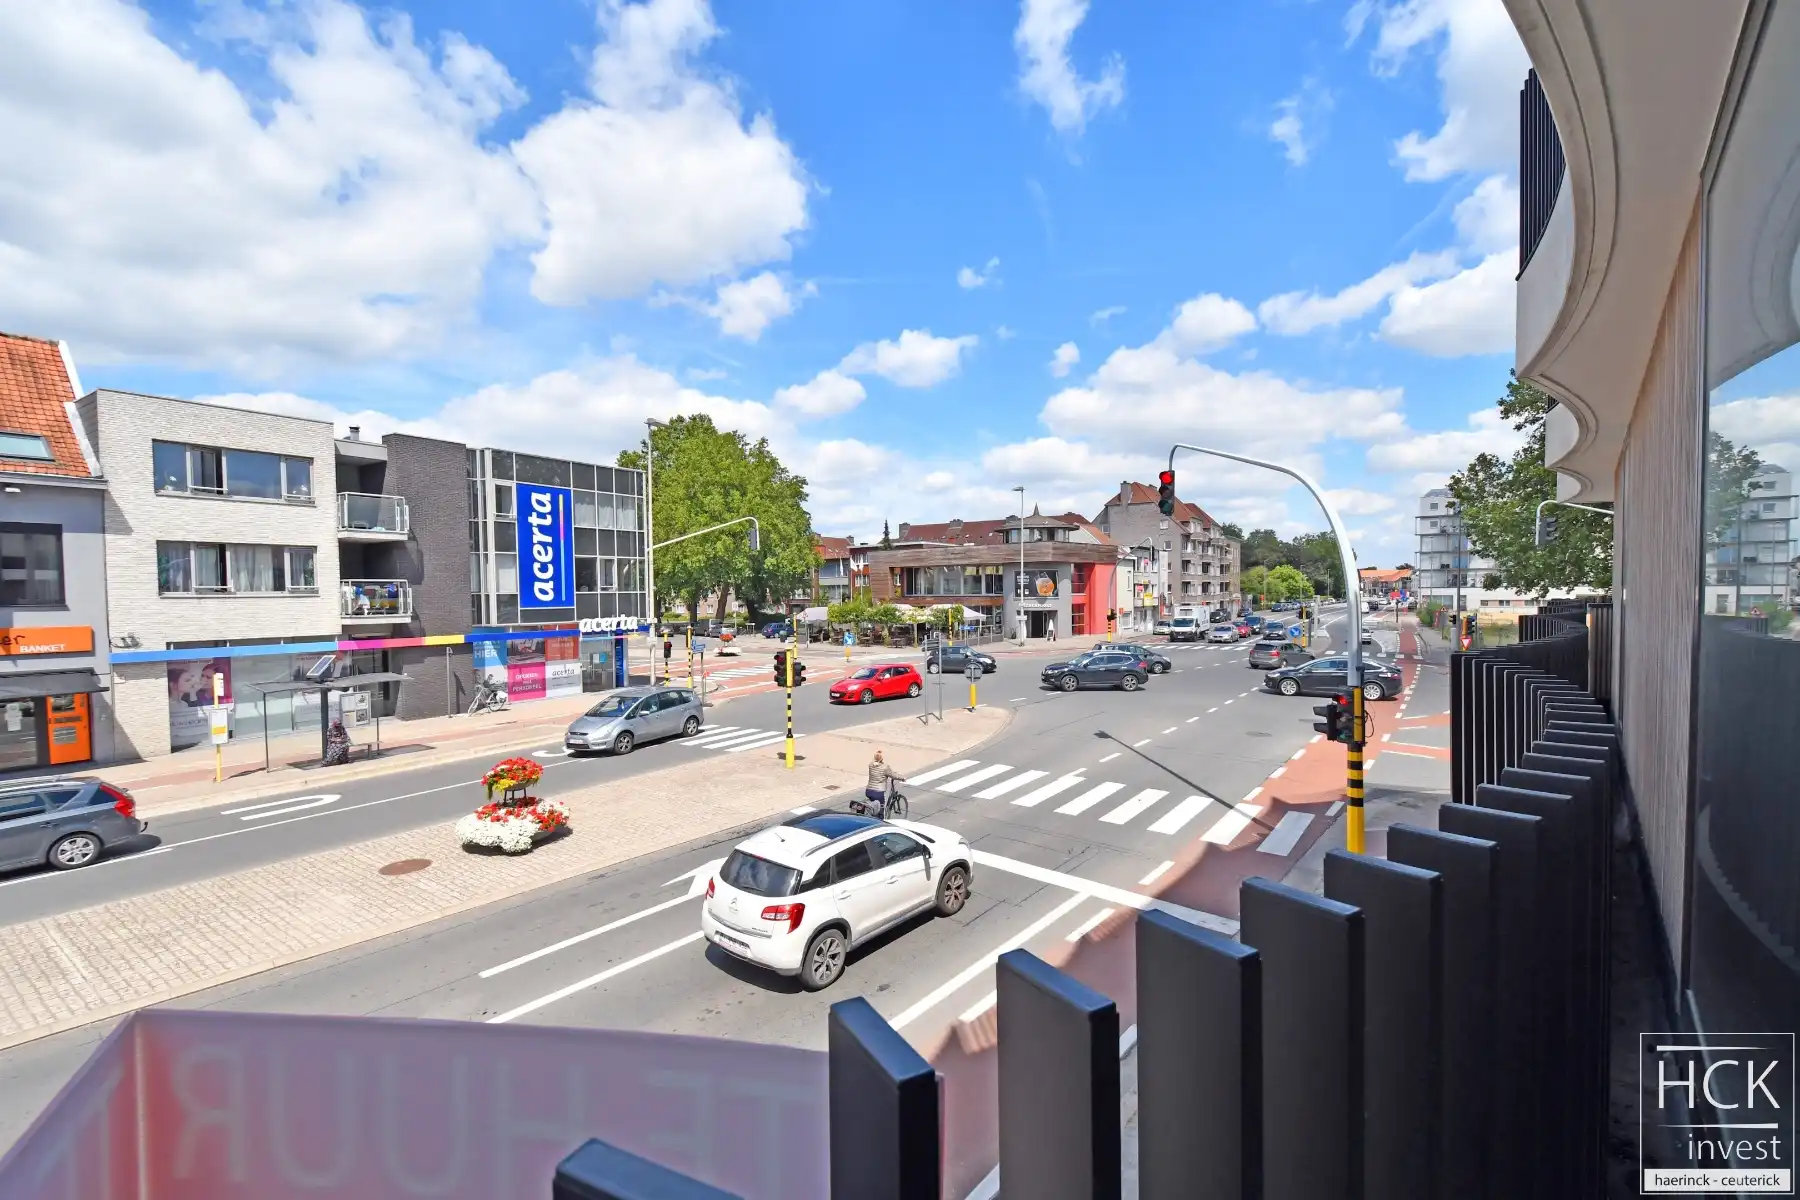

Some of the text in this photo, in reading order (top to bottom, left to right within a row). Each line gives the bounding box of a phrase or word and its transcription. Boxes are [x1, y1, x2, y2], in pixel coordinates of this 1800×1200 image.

[528, 492, 554, 602] acerta
[580, 614, 637, 632] acerta
[20, 644, 65, 653] BANKET
